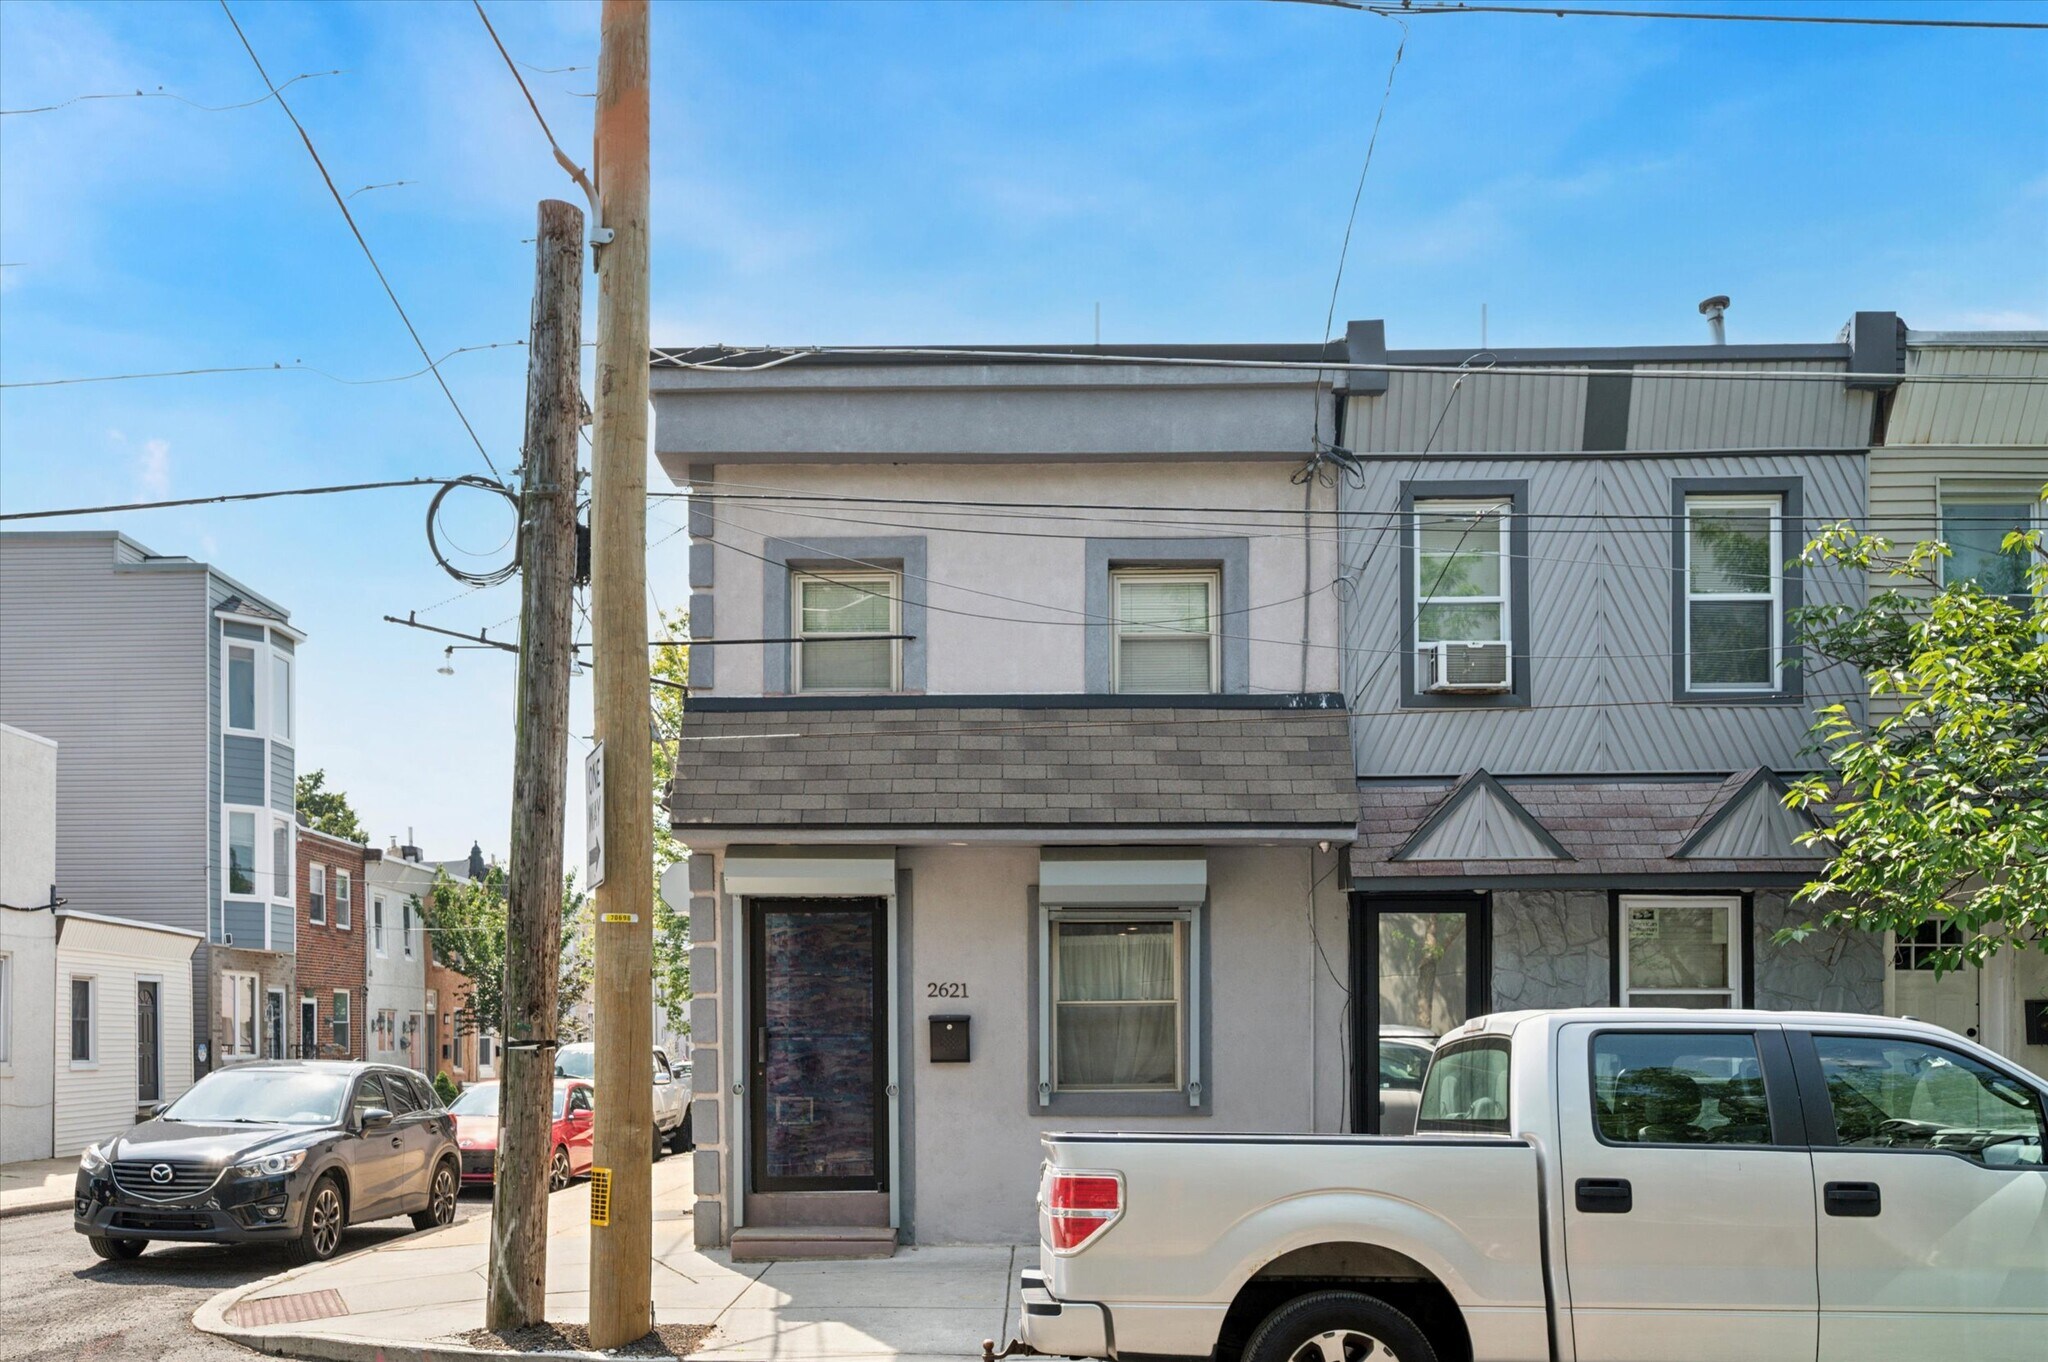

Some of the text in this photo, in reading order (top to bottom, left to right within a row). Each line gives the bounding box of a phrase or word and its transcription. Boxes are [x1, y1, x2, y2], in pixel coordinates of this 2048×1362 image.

[588, 758, 601, 796] ONE
[588, 796, 602, 834] WAY
[927, 982, 969, 998] 2621
